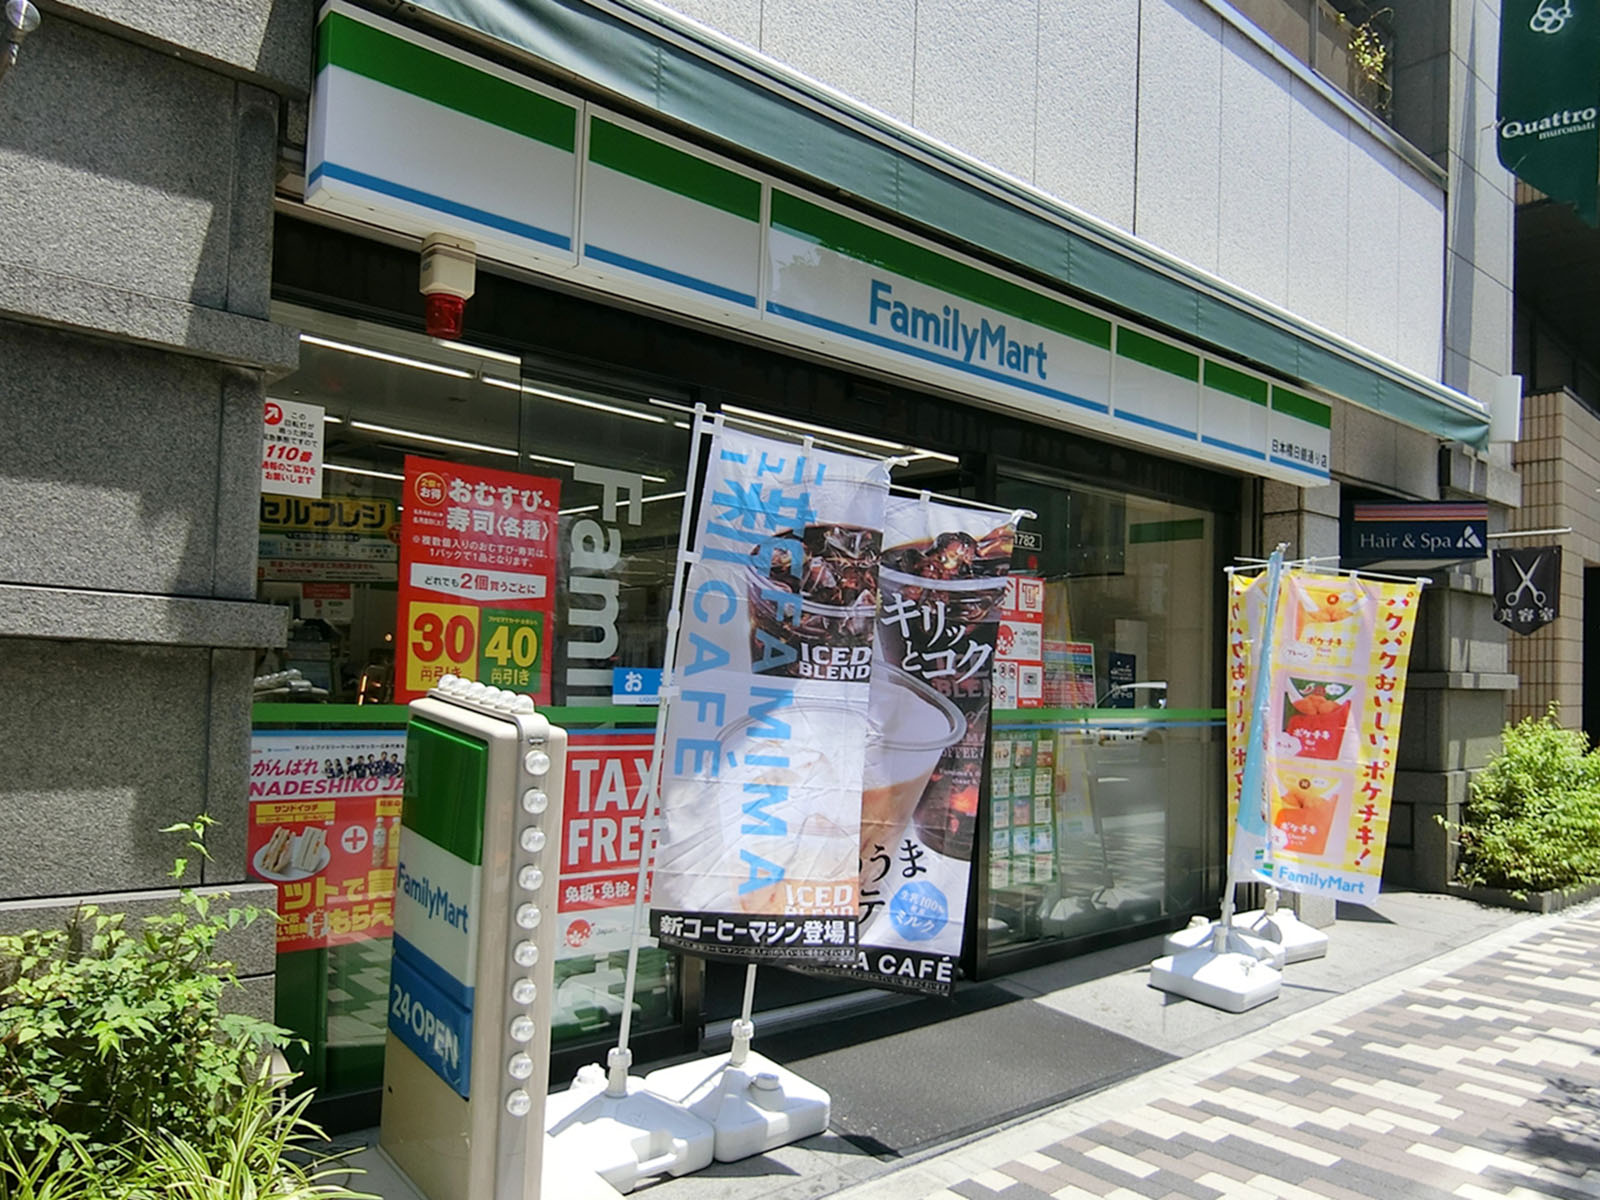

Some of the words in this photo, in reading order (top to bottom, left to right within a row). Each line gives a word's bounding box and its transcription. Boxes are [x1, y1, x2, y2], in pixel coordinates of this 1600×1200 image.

[1502, 108, 1596, 138] Quattro
[870, 279, 1047, 380] FamilyMart
[266, 444, 313, 463] 110番
[260, 496, 386, 529] セルフレジ
[1360, 533, 1398, 548] Hair
[1402, 533, 1416, 549] &
[1421, 533, 1452, 552] Spa
[881, 593, 967, 648] キリッ
[412, 612, 475, 664] 30
[485, 625, 538, 668] 40
[800, 644, 873, 667] ICED
[902, 640, 993, 685] とコク
[490, 668, 531, 686] 円引き
[674, 579, 738, 778] CAFÉ
[800, 663, 872, 682] BLEND
[738, 588, 804, 896] FAMIMA
[250, 758, 319, 777] がんばれ
[248, 778, 379, 797] NADESHIKO
[859, 839, 927, 883] うま
[1278, 865, 1366, 894] FamilyMart
[398, 862, 469, 935] FamilyMart
[785, 884, 853, 907] ICED
[660, 914, 857, 946] 新コーヒーマシン登場!
[878, 954, 953, 984] CAFÉ
